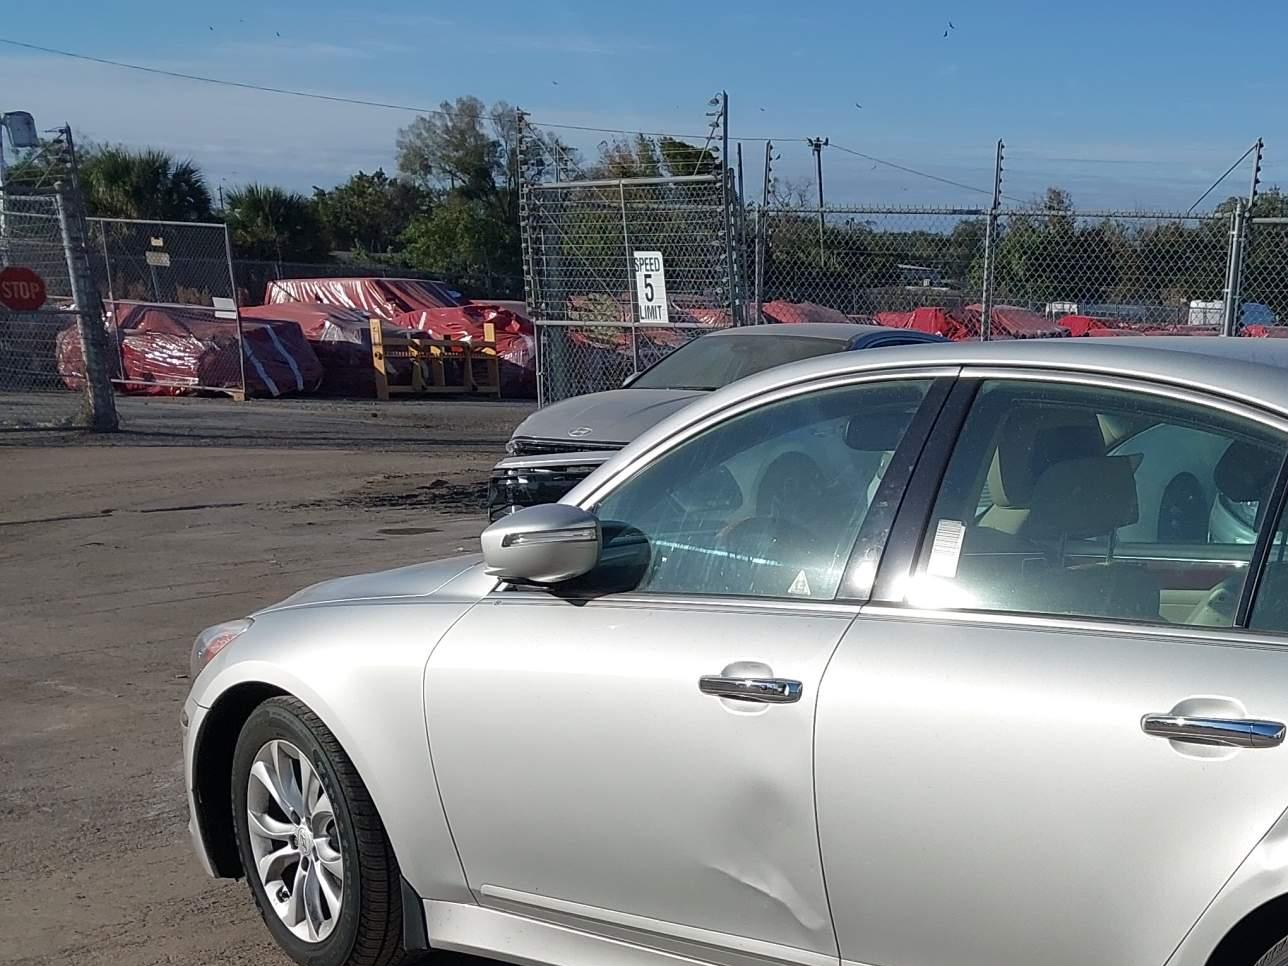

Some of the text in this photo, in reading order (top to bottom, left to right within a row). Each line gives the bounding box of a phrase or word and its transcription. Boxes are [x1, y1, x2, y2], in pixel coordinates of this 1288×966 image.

[634, 257, 660, 272] SPEED
[1, 281, 40, 300] STOP
[644, 274, 654, 302] 5
[640, 304, 662, 320] LIMIT
